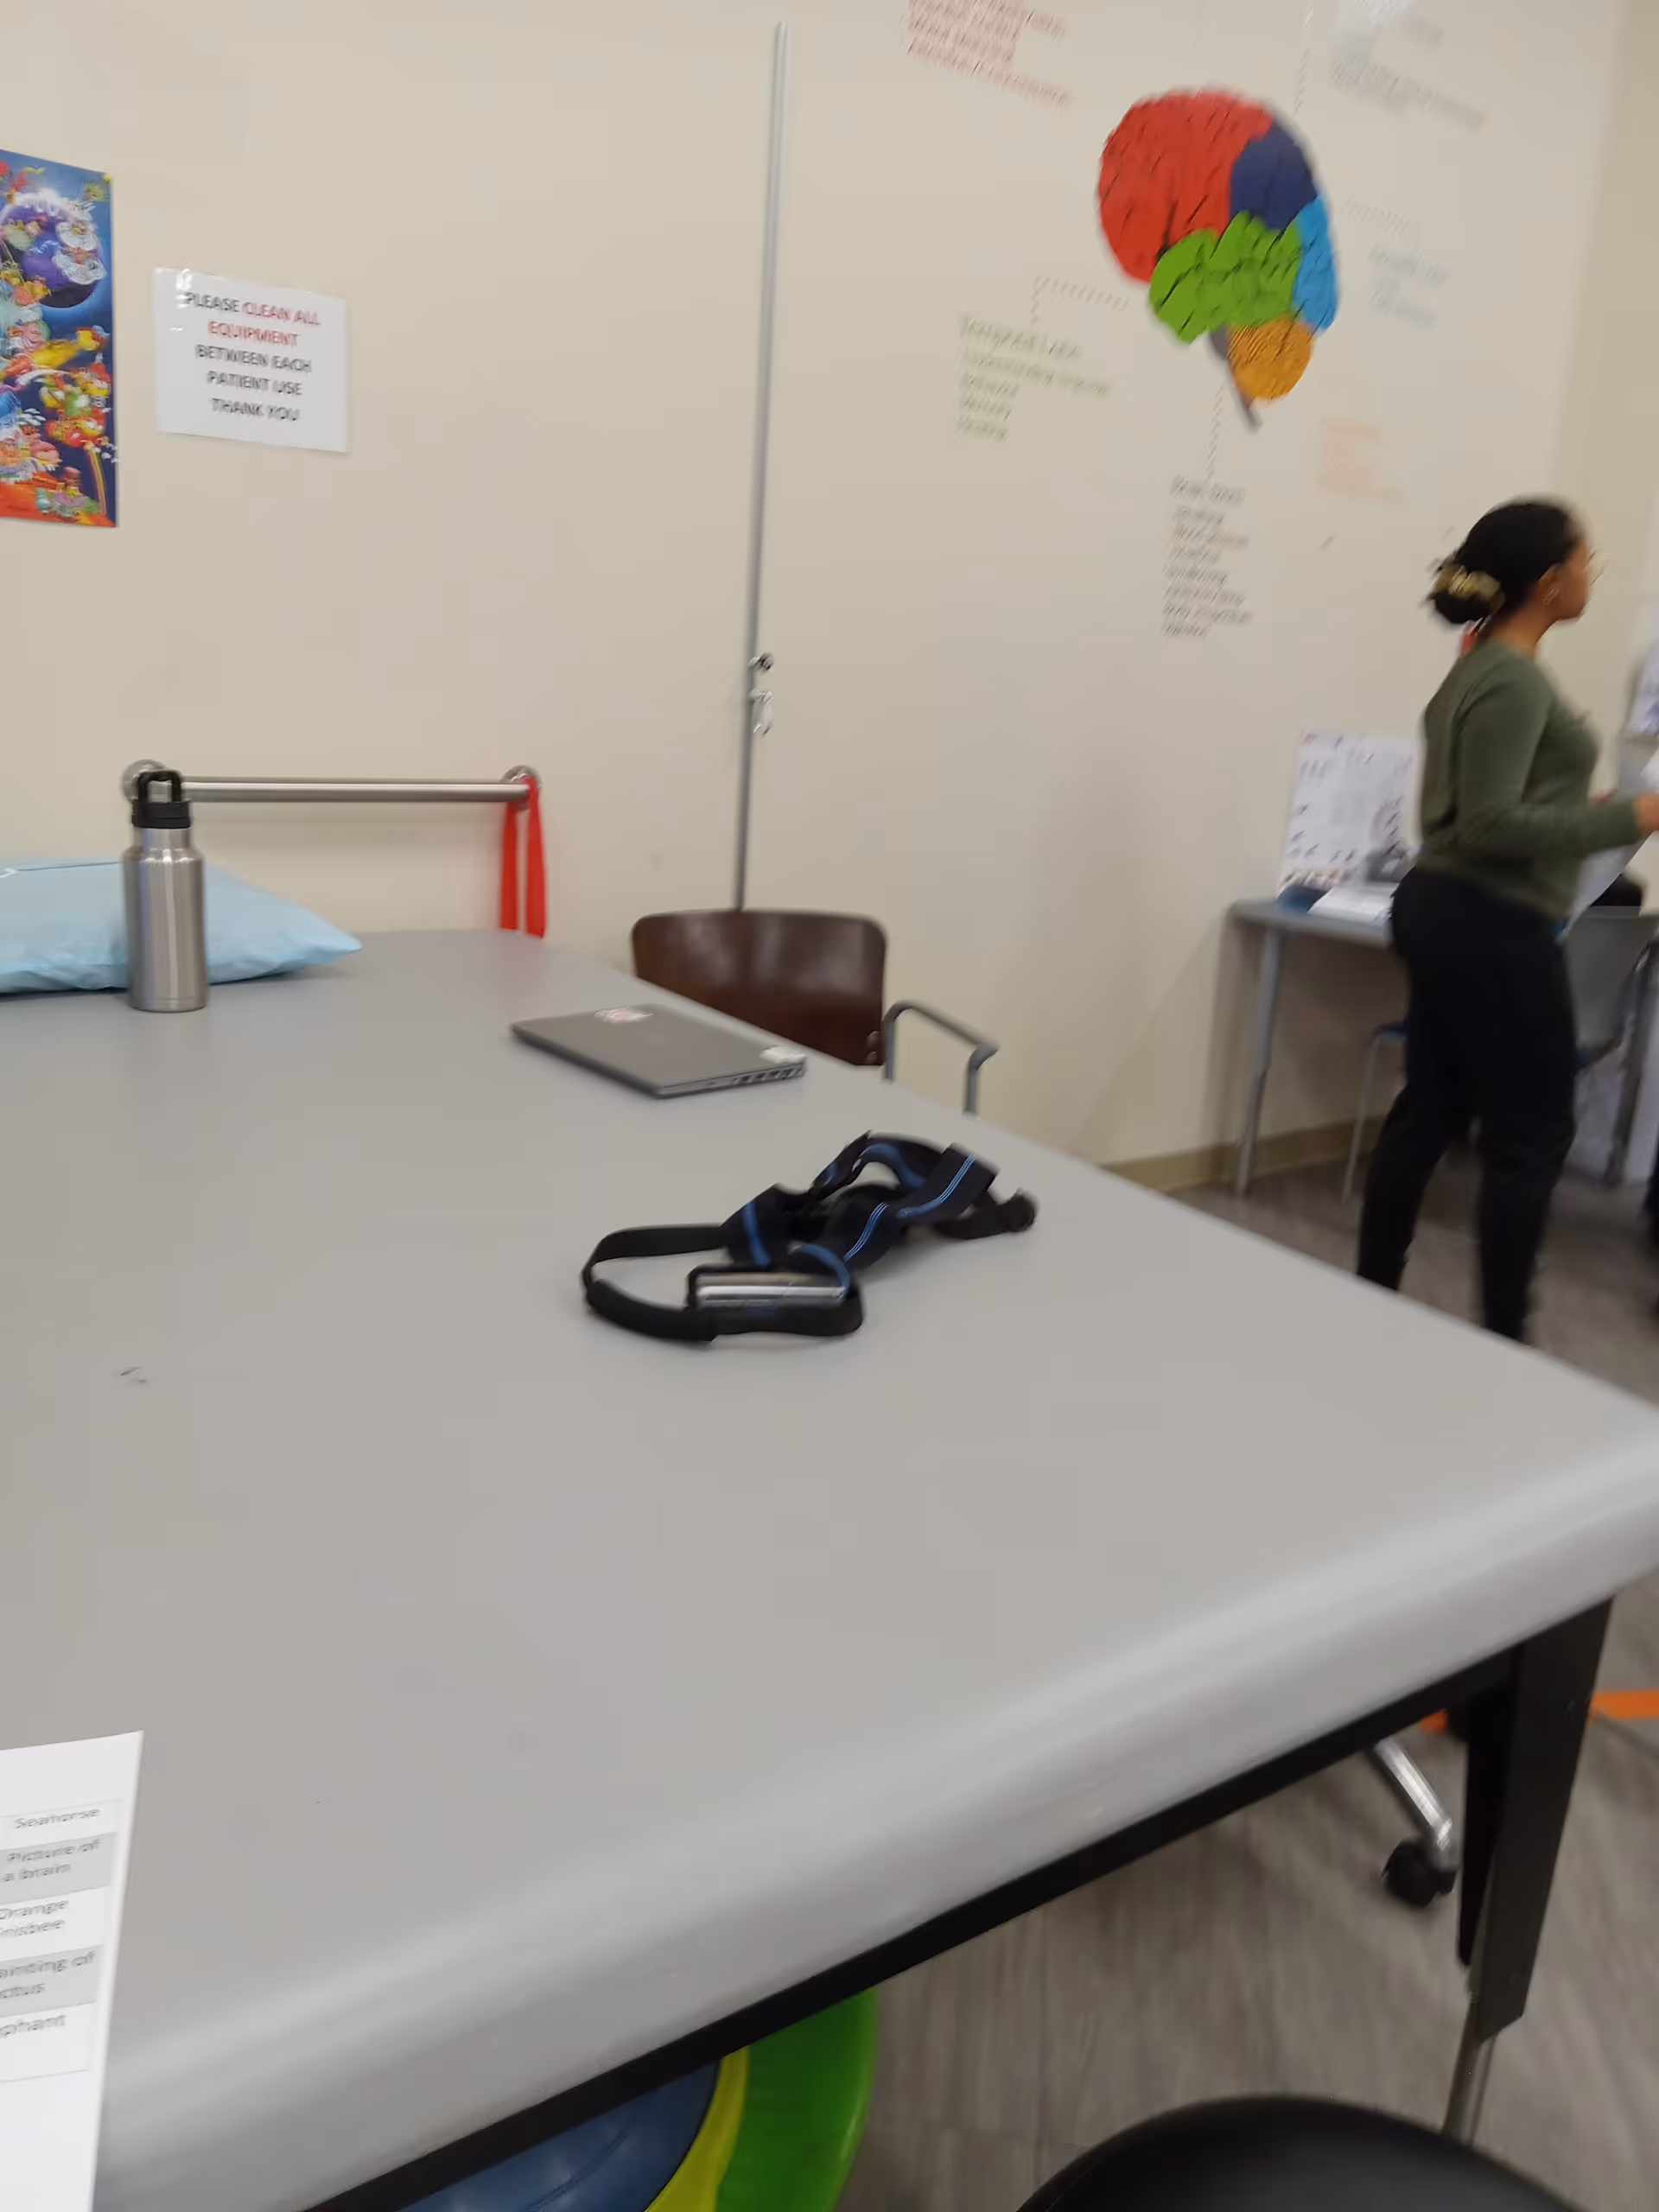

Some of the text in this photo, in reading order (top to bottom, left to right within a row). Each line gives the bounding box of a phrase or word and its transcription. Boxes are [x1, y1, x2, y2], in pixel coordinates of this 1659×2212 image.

[184, 291, 320, 326] PLEASE CLEAN ALL
[208, 321, 299, 346] EQUIPMENT
[195, 345, 312, 372] BETWEEN EACH
[207, 371, 302, 396] PATIENT USE
[212, 397, 300, 422] THANK YOU
[15, 1808, 100, 1828] Seahorse
[79, 1839, 100, 1853] of
[20, 1863, 72, 1880] brain
[0, 1959, 68, 1979] ainting
